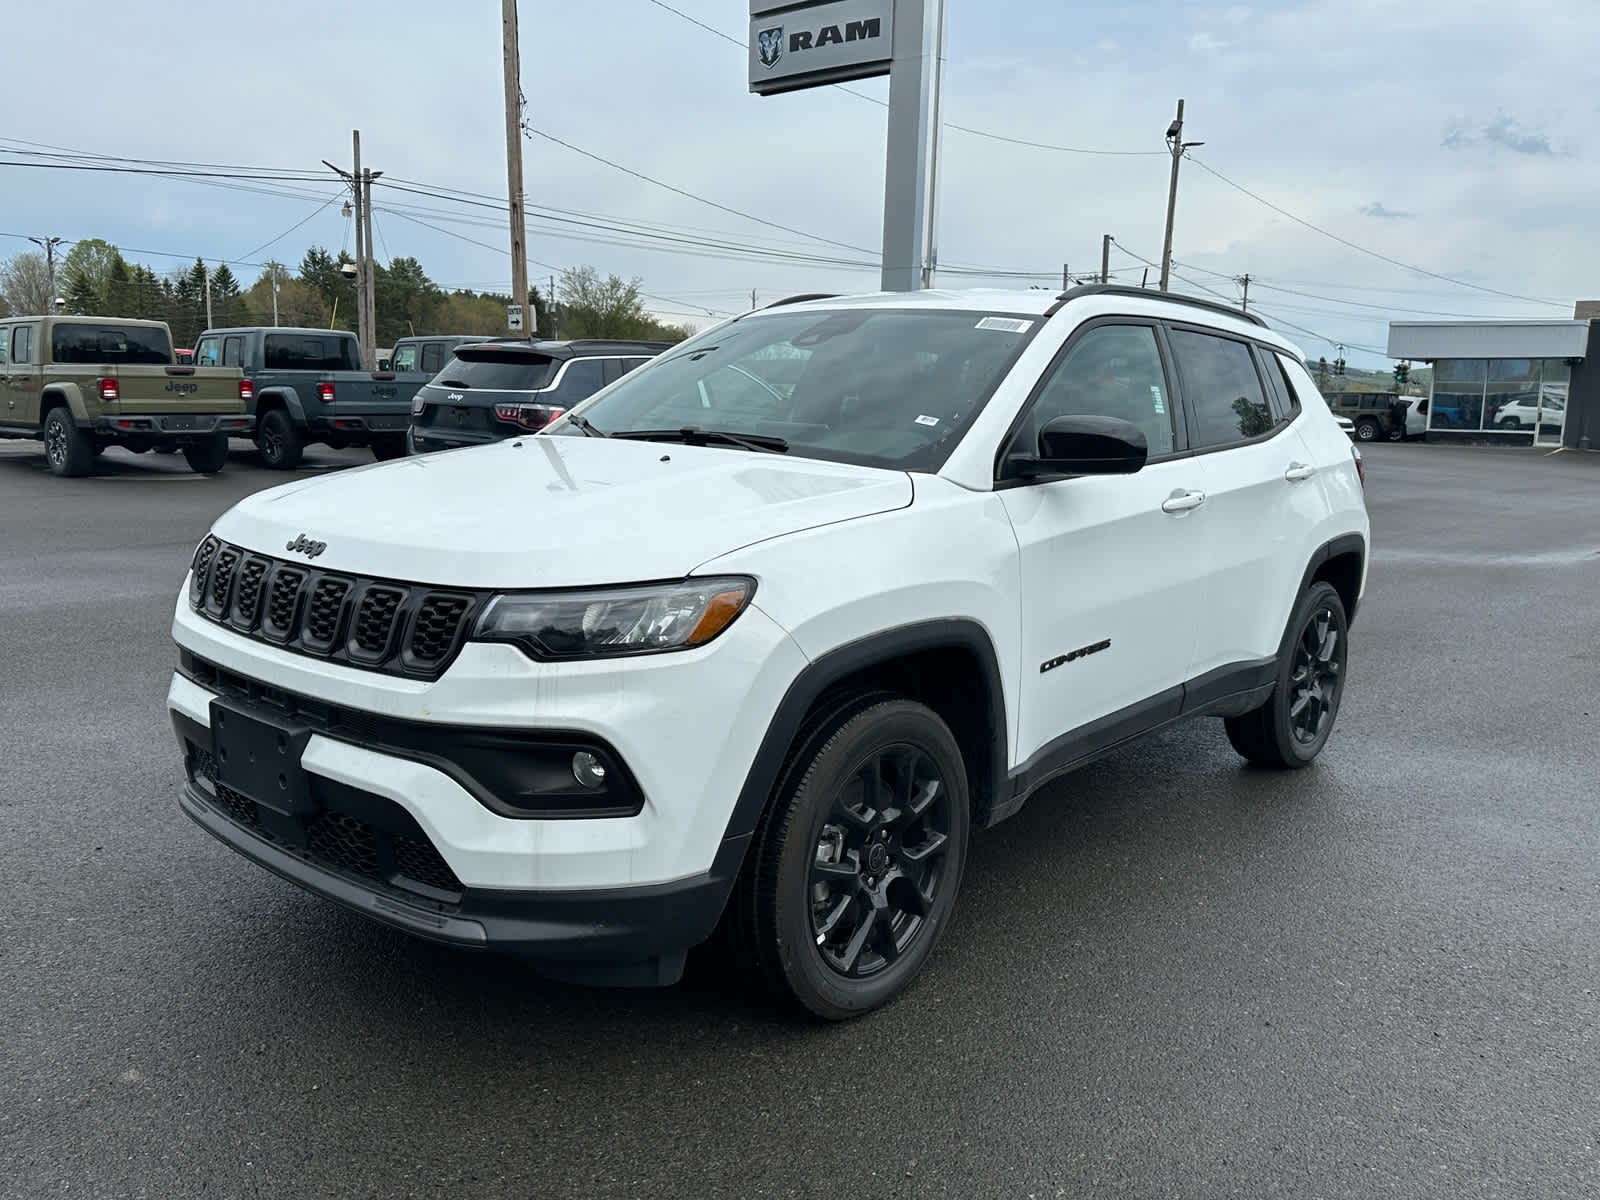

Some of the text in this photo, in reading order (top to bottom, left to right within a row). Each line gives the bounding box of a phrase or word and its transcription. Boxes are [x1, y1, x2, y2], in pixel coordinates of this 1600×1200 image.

[789, 18, 881, 52] RAM
[165, 381, 198, 393] Jeep
[447, 392, 464, 401] Jeep
[286, 533, 327, 560] Jeep
